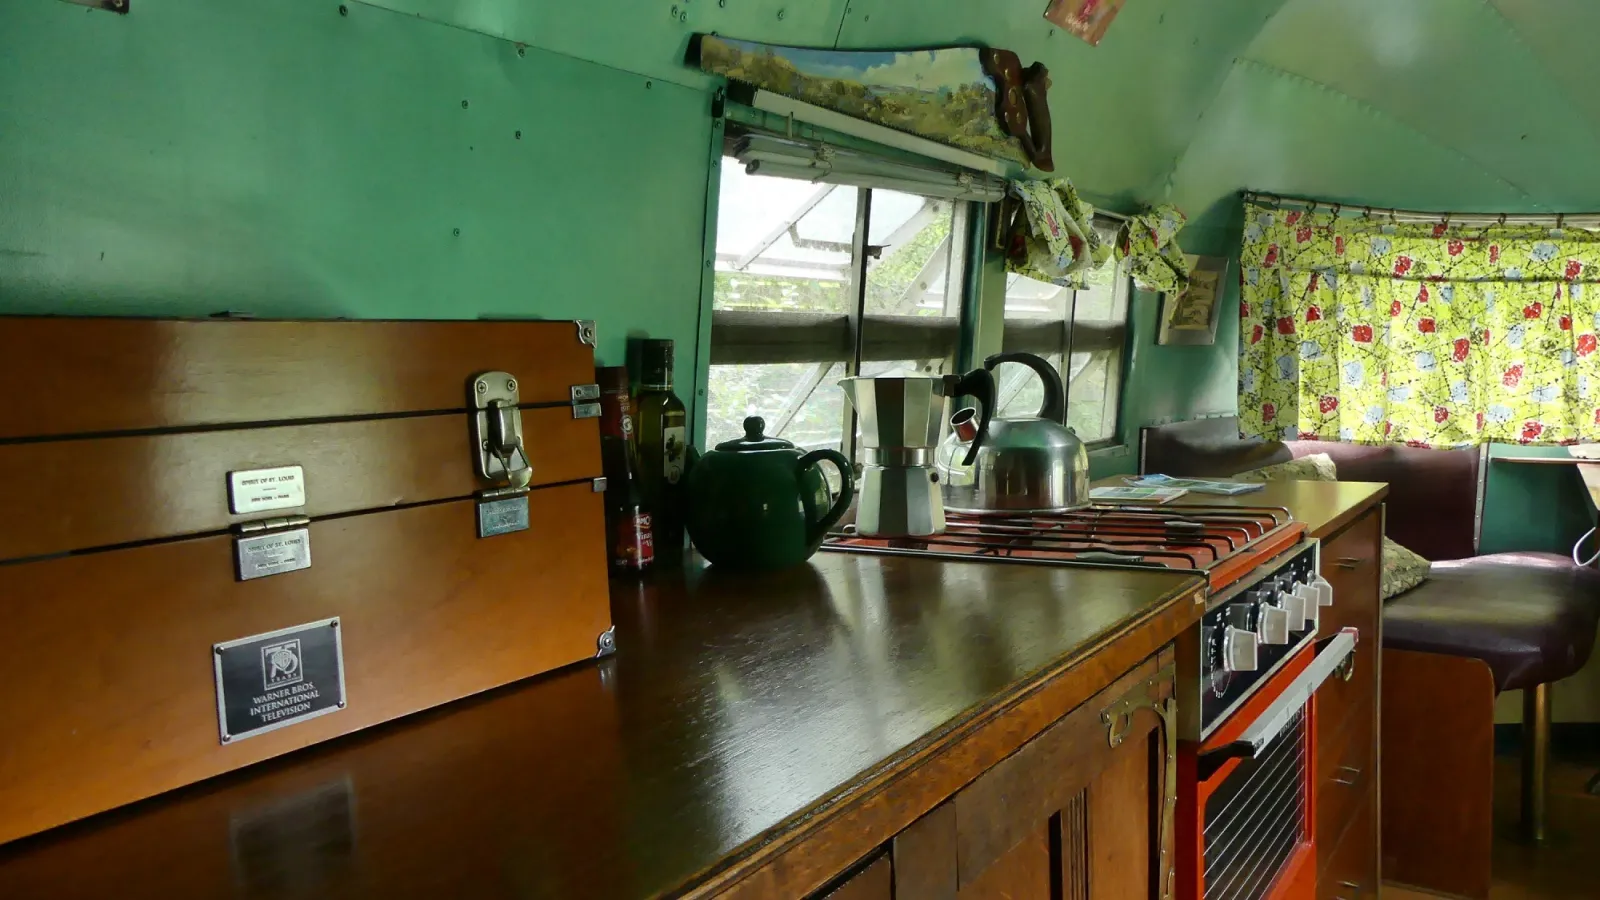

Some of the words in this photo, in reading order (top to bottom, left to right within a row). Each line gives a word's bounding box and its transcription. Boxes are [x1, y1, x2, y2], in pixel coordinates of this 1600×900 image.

[250, 690, 320, 716] INTERNATIONAL
[252, 688, 291, 704] WARNER
[291, 681, 316, 693] BROS.
[261, 701, 311, 722] TELEVISION
